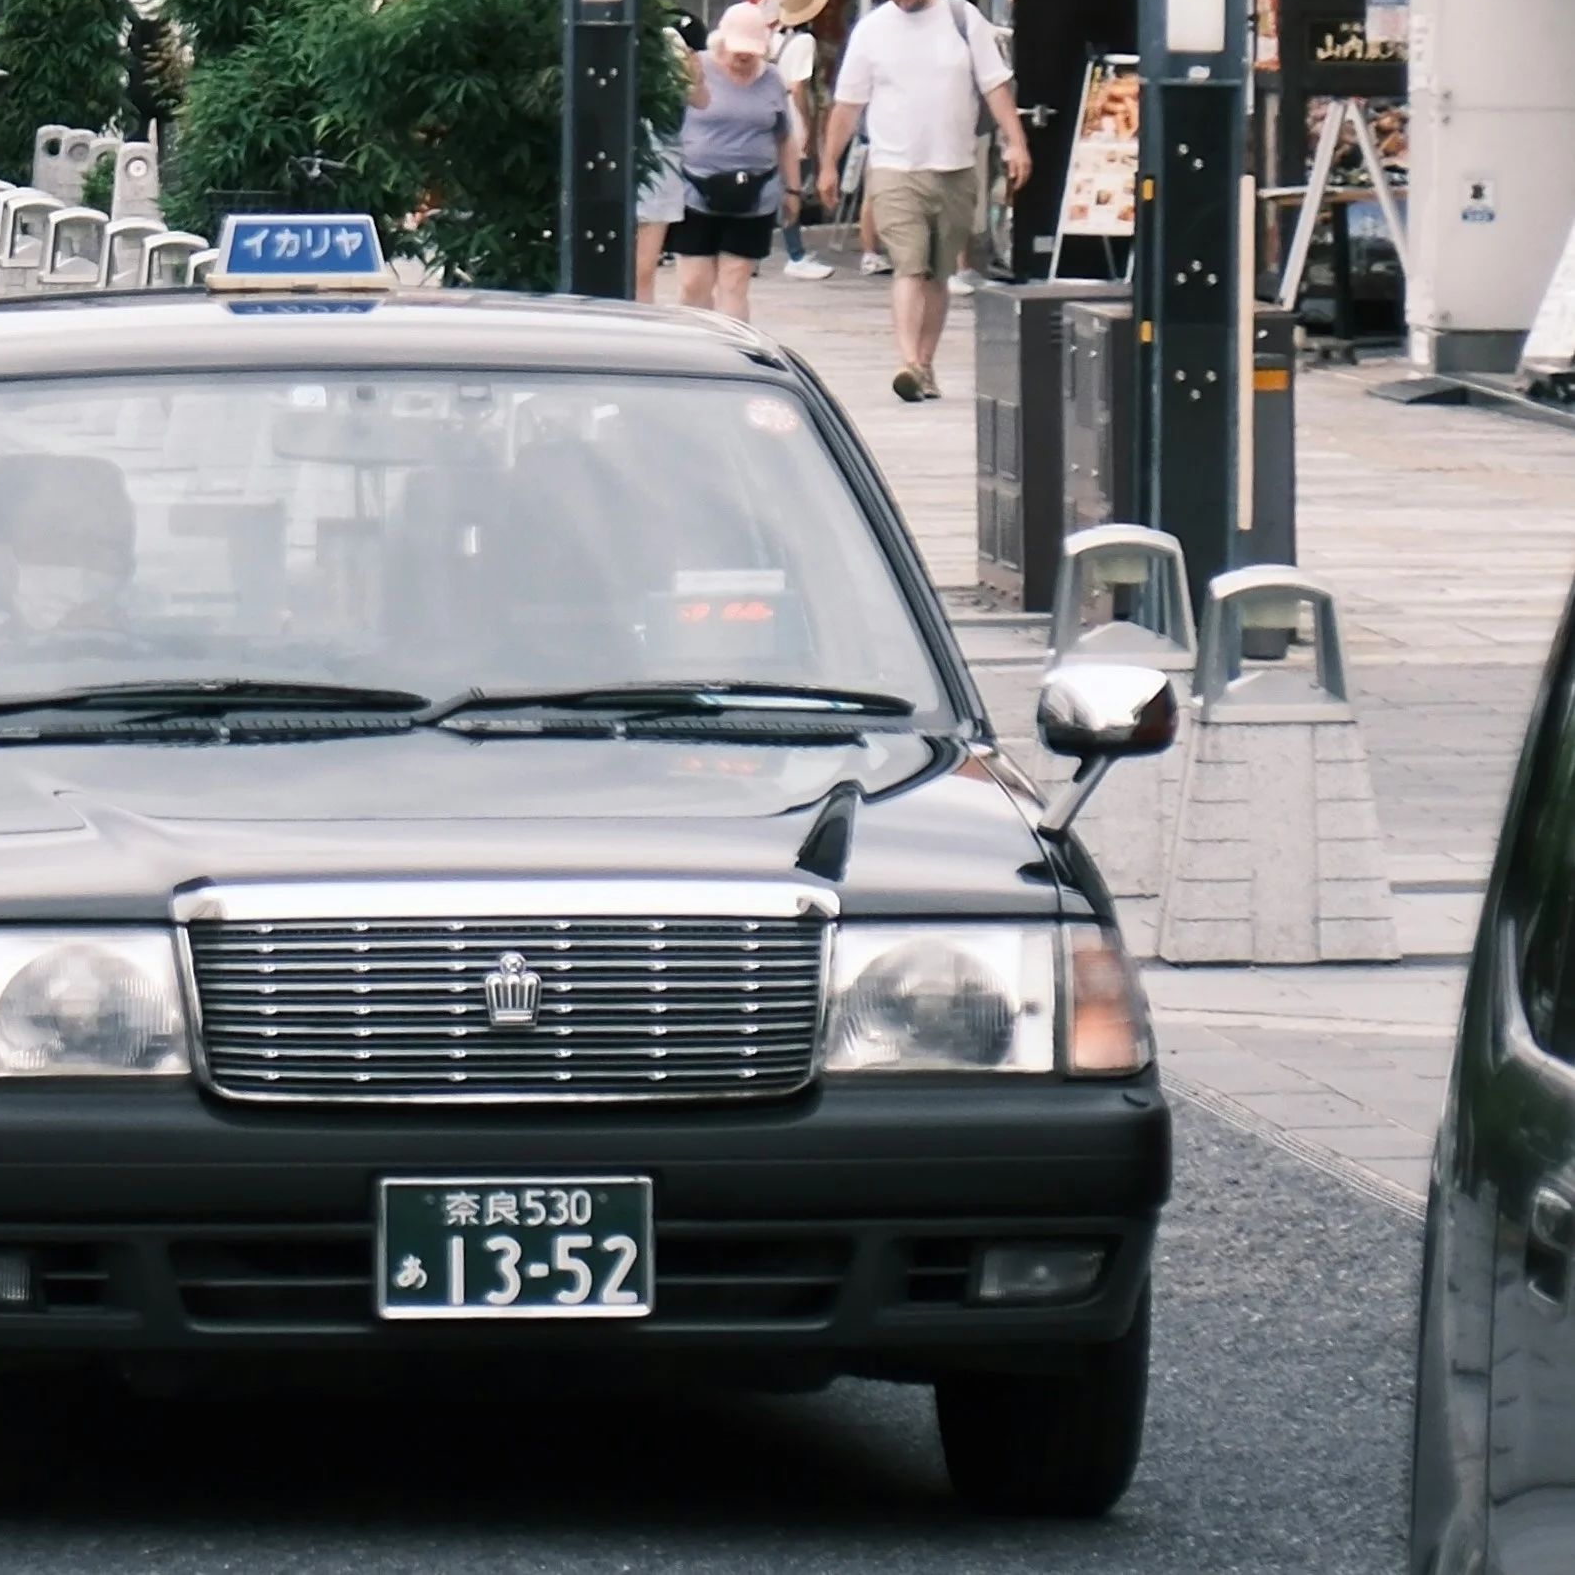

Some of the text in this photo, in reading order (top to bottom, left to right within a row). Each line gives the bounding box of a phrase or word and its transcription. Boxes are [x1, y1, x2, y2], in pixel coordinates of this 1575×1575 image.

[243, 229, 364, 261] イカリヤ
[445, 1189, 593, 1226] 奈良530
[395, 1234, 639, 1306] あ 13-52
